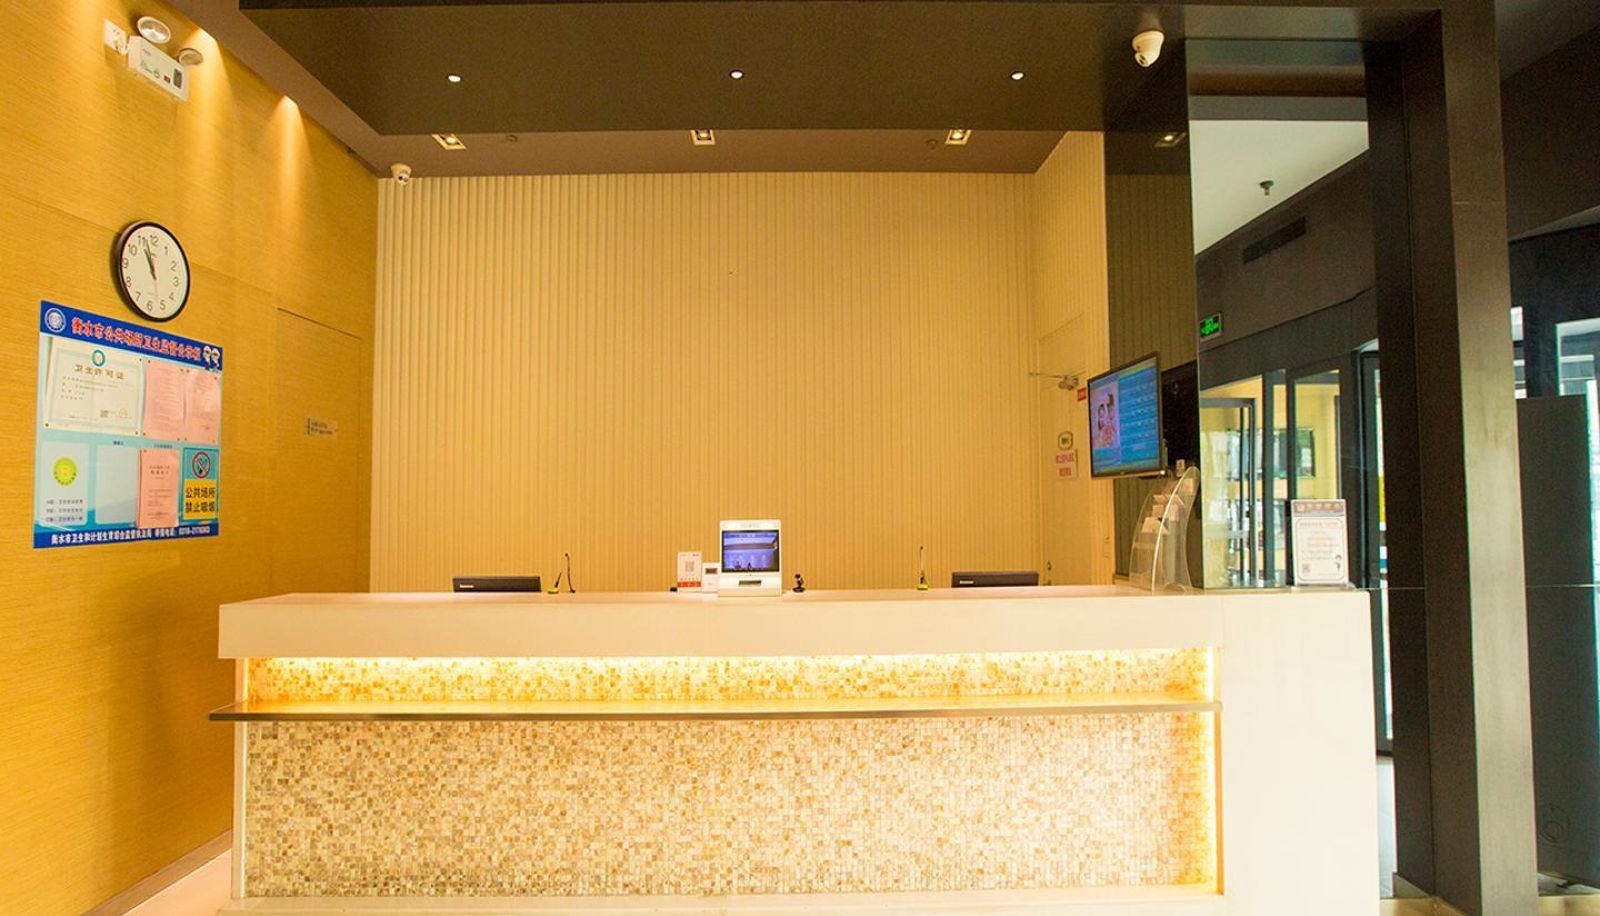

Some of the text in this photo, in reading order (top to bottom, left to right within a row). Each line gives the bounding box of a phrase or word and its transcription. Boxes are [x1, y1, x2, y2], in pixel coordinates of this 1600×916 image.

[150, 234, 159, 247] 12
[128, 244, 137, 256] 10
[164, 246, 169, 256] 1
[122, 258, 128, 269] 9
[170, 261, 177, 271] 2
[126, 277, 131, 288] 8
[172, 277, 179, 287] 3
[135, 291, 141, 302] 7
[169, 292, 174, 301] 4
[147, 301, 153, 311] 6
[160, 300, 166, 310] 5
[185, 487, 215, 499] 公共场所
[185, 501, 215, 514] 禁止吸烟
